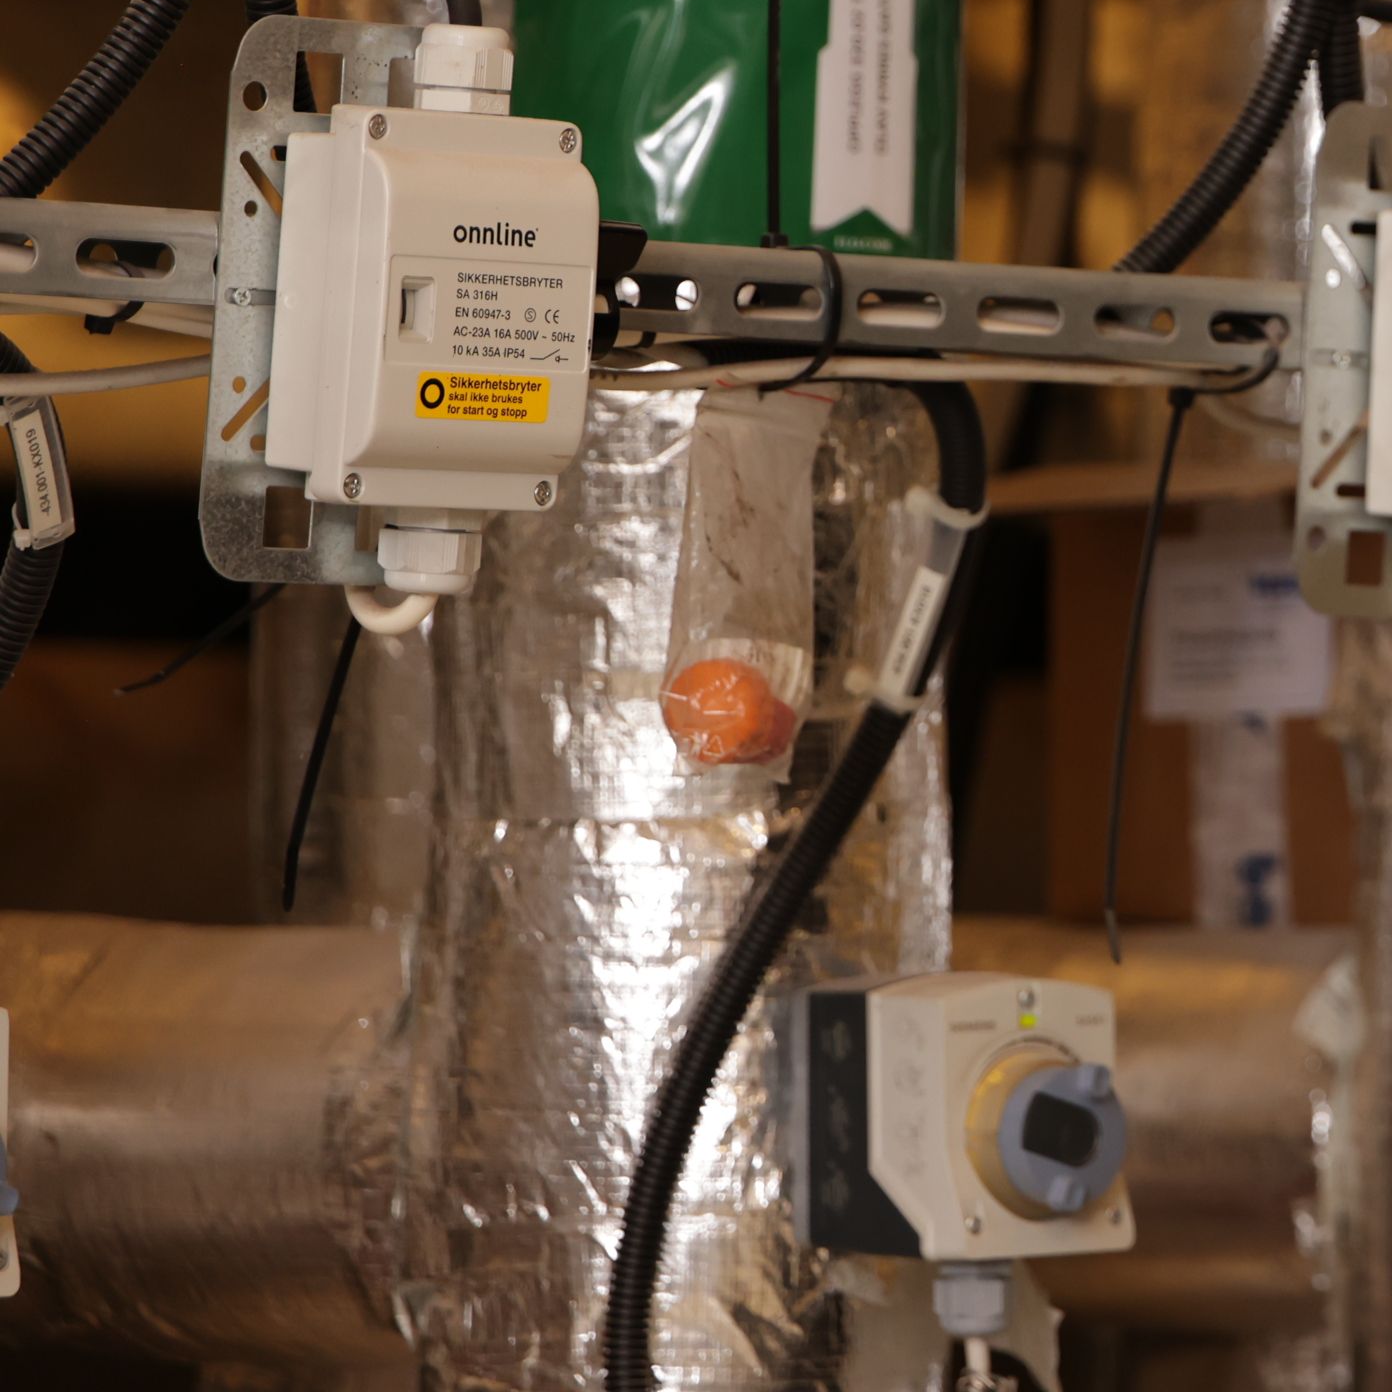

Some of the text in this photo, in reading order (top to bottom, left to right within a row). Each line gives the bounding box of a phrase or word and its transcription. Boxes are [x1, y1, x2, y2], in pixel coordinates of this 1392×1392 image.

[453, 222, 536, 248] onnline
[457, 272, 564, 289] SIKKERHETSBRYTER
[456, 288, 498, 301] SA 316H
[455, 307, 469, 318] EN
[472, 308, 511, 320] 60947-3
[453, 326, 491, 339] AC-23A
[494, 328, 512, 339] 16A
[514, 329, 539, 341] 500V
[551, 331, 576, 343] 50Hz
[452, 344, 526, 359] 10 kA 35A IP54
[450, 376, 542, 394] Sikkerhetsbryter
[448, 392, 523, 404] skal ikke brukes
[447, 403, 527, 419] for start og stopp
